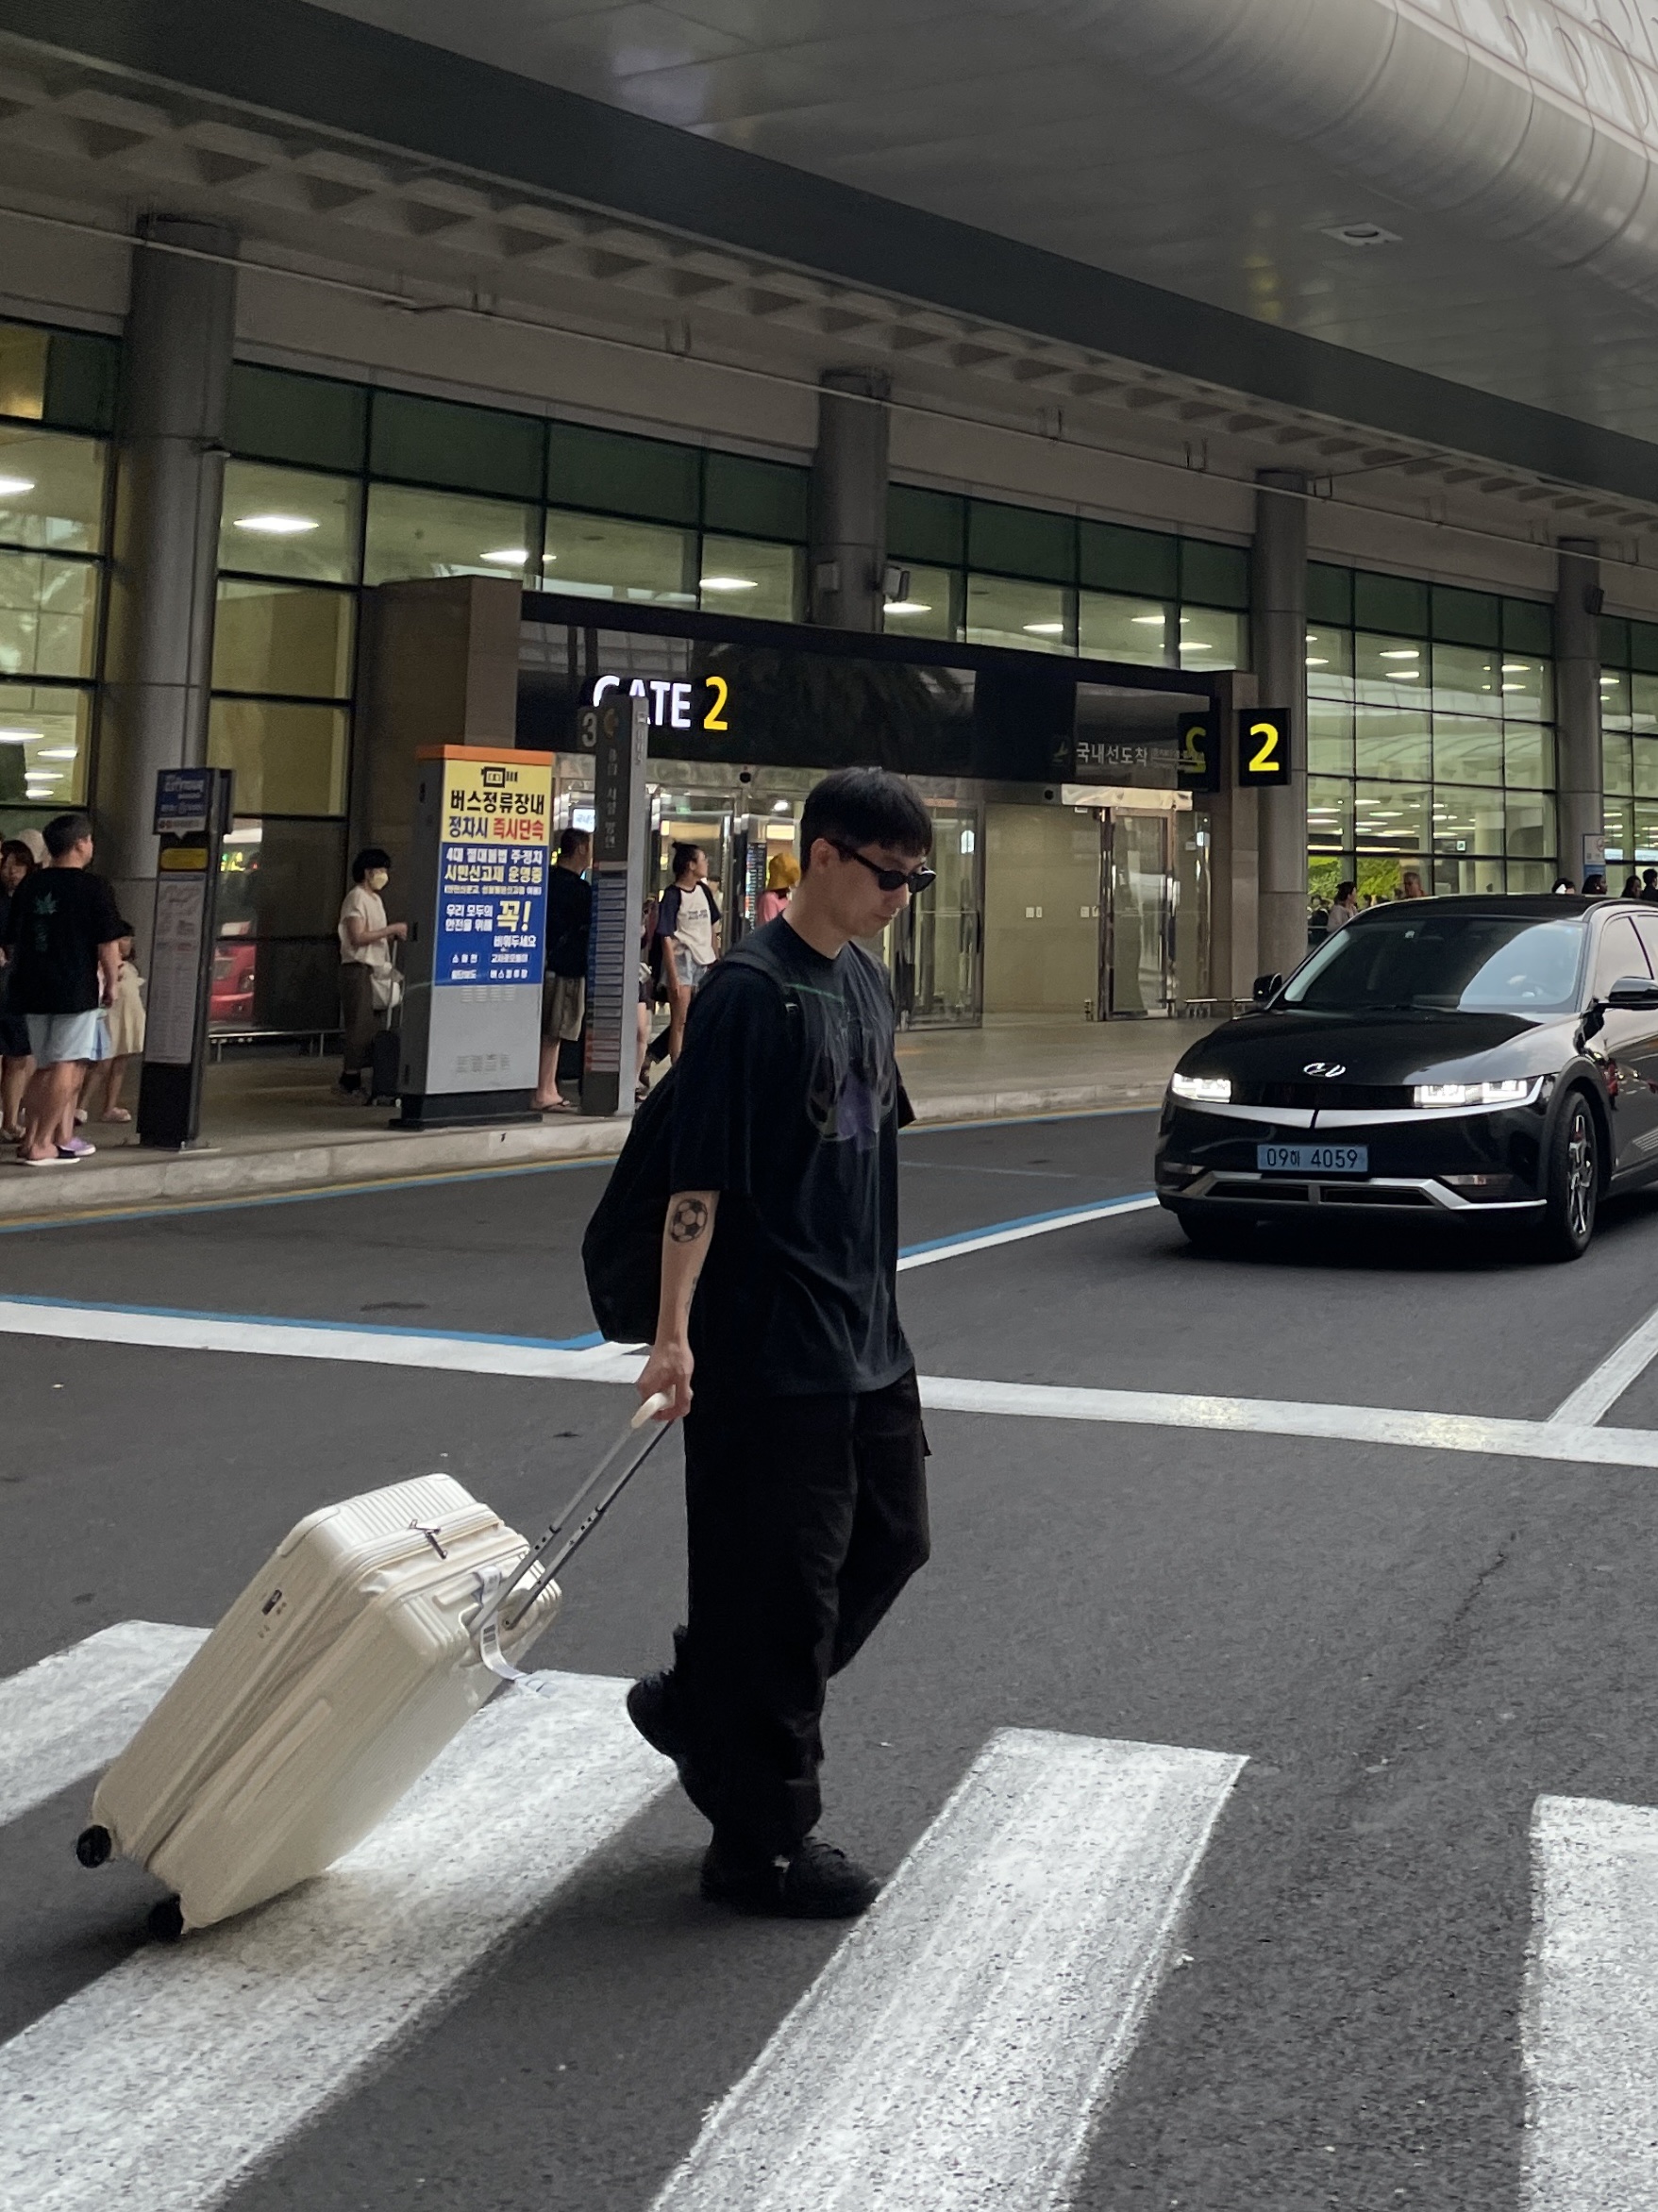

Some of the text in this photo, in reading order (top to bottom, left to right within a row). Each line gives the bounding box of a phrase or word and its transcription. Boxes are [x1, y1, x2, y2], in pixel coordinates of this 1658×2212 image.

[703, 676, 729, 730] 2
[1076, 741, 1148, 766] 국내선도착
[1248, 723, 1280, 772] 2
[450, 789, 544, 815] 버스정류장내
[449, 815, 544, 841] 정차시 즉시단속
[1311, 1148, 1358, 1168] 4059
